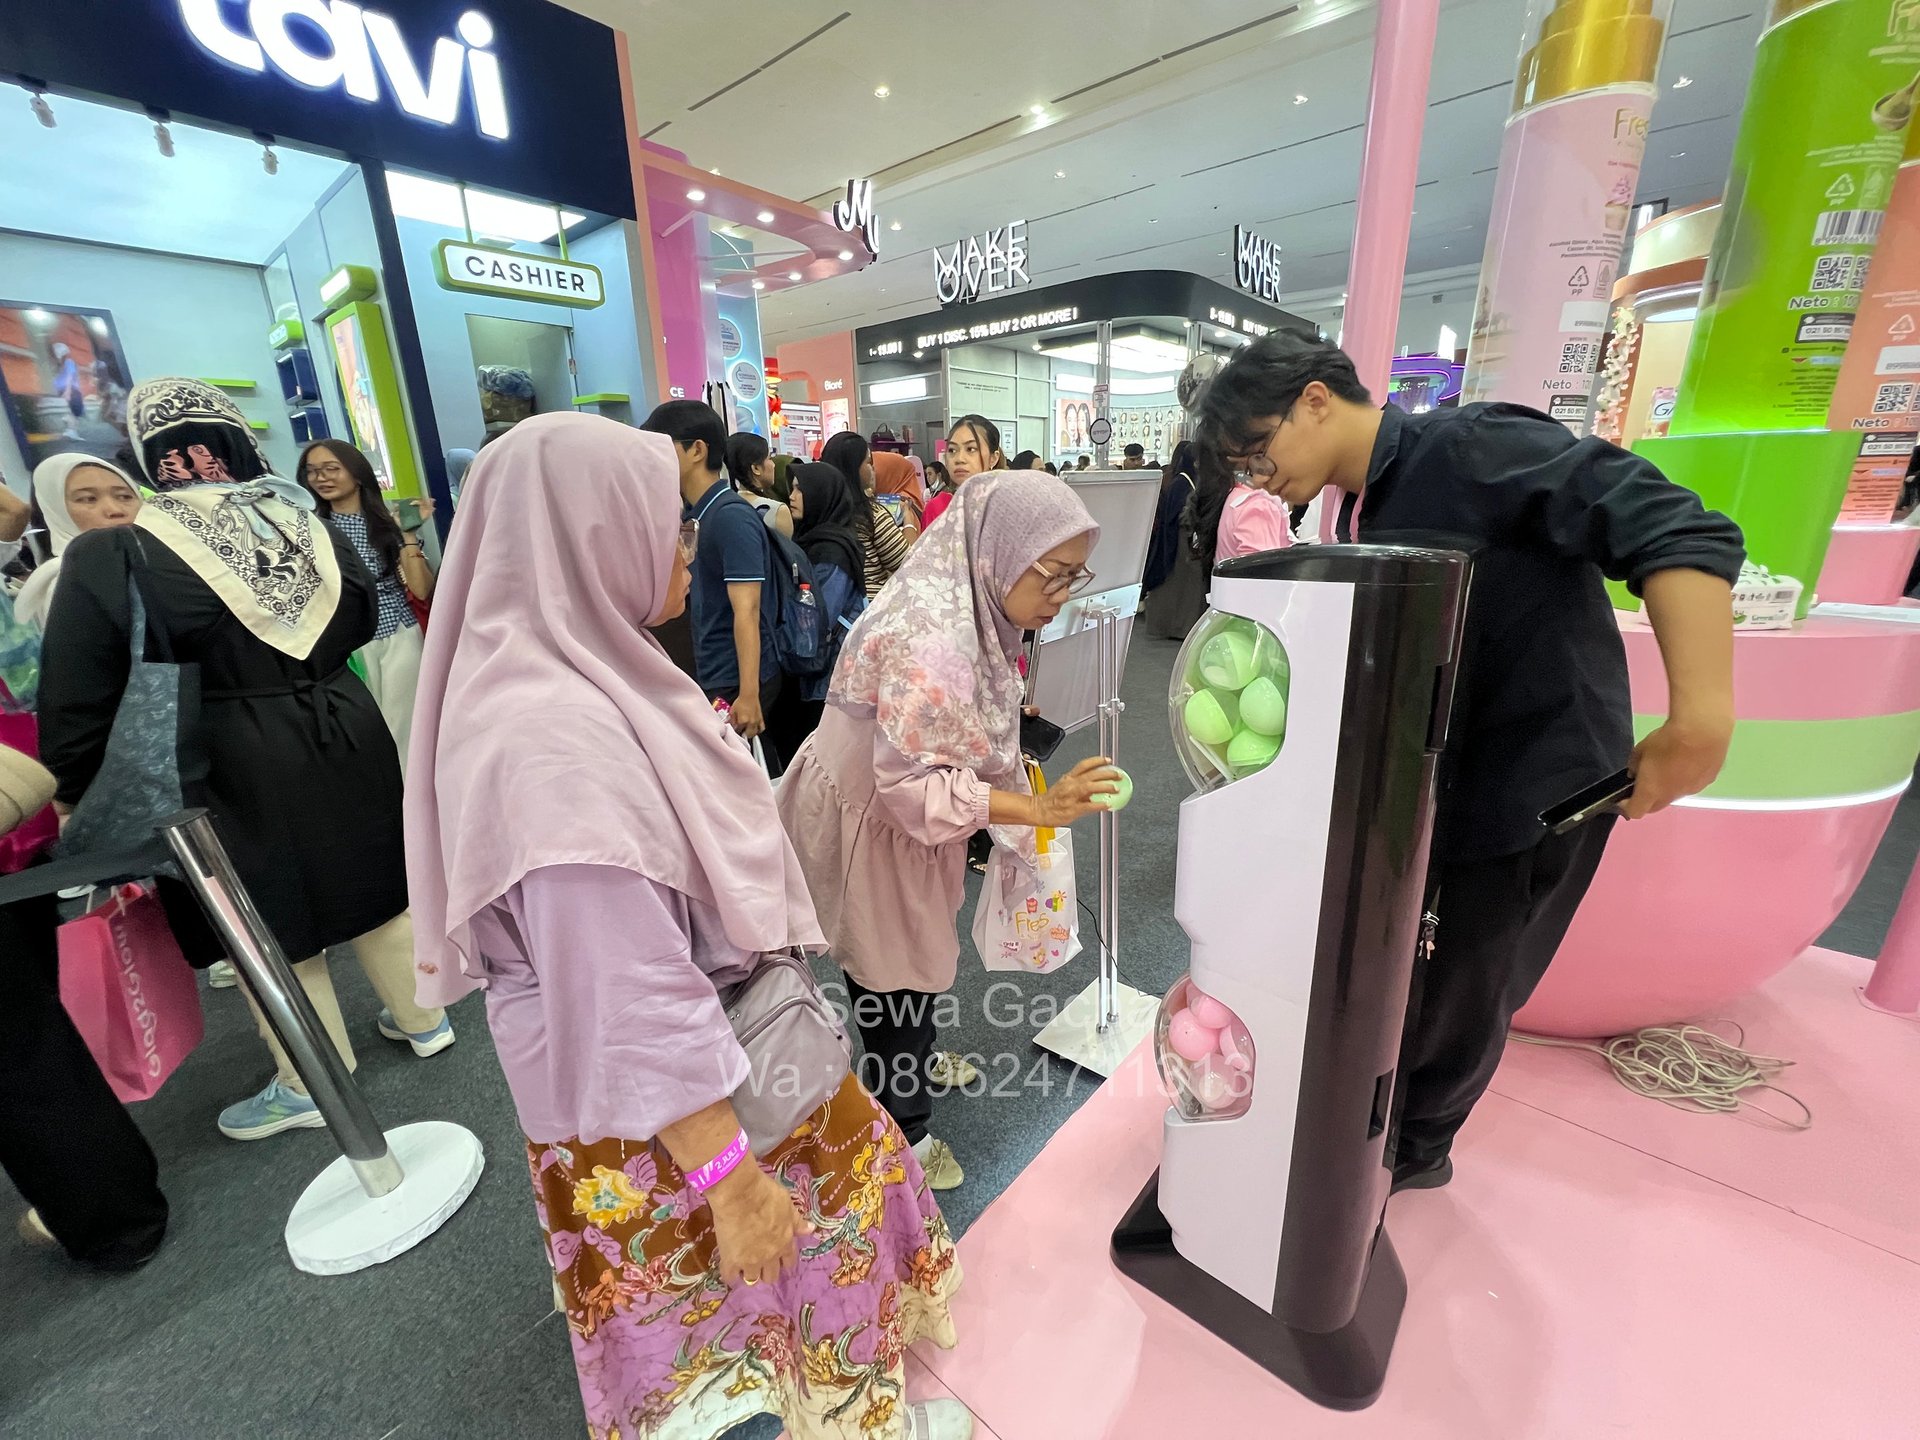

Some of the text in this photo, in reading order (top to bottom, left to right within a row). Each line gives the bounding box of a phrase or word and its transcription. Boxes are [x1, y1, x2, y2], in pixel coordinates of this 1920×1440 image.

[934, 219, 1028, 281] MAKE
[1237, 224, 1282, 278] MAKE
[464, 255, 585, 293] CASHIER
[937, 246, 1031, 302] OVER
[1789, 296, 1829, 309] Neto
[917, 333, 937, 349] BUY
[989, 319, 1011, 336] BUY
[1011, 318, 1020, 331] 2
[1020, 314, 1037, 330] OR
[1038, 307, 1072, 326] MORE
[824, 378, 843, 391] Bioré
[1542, 379, 1572, 390] Neto
[1852, 418, 1890, 428] Neto
